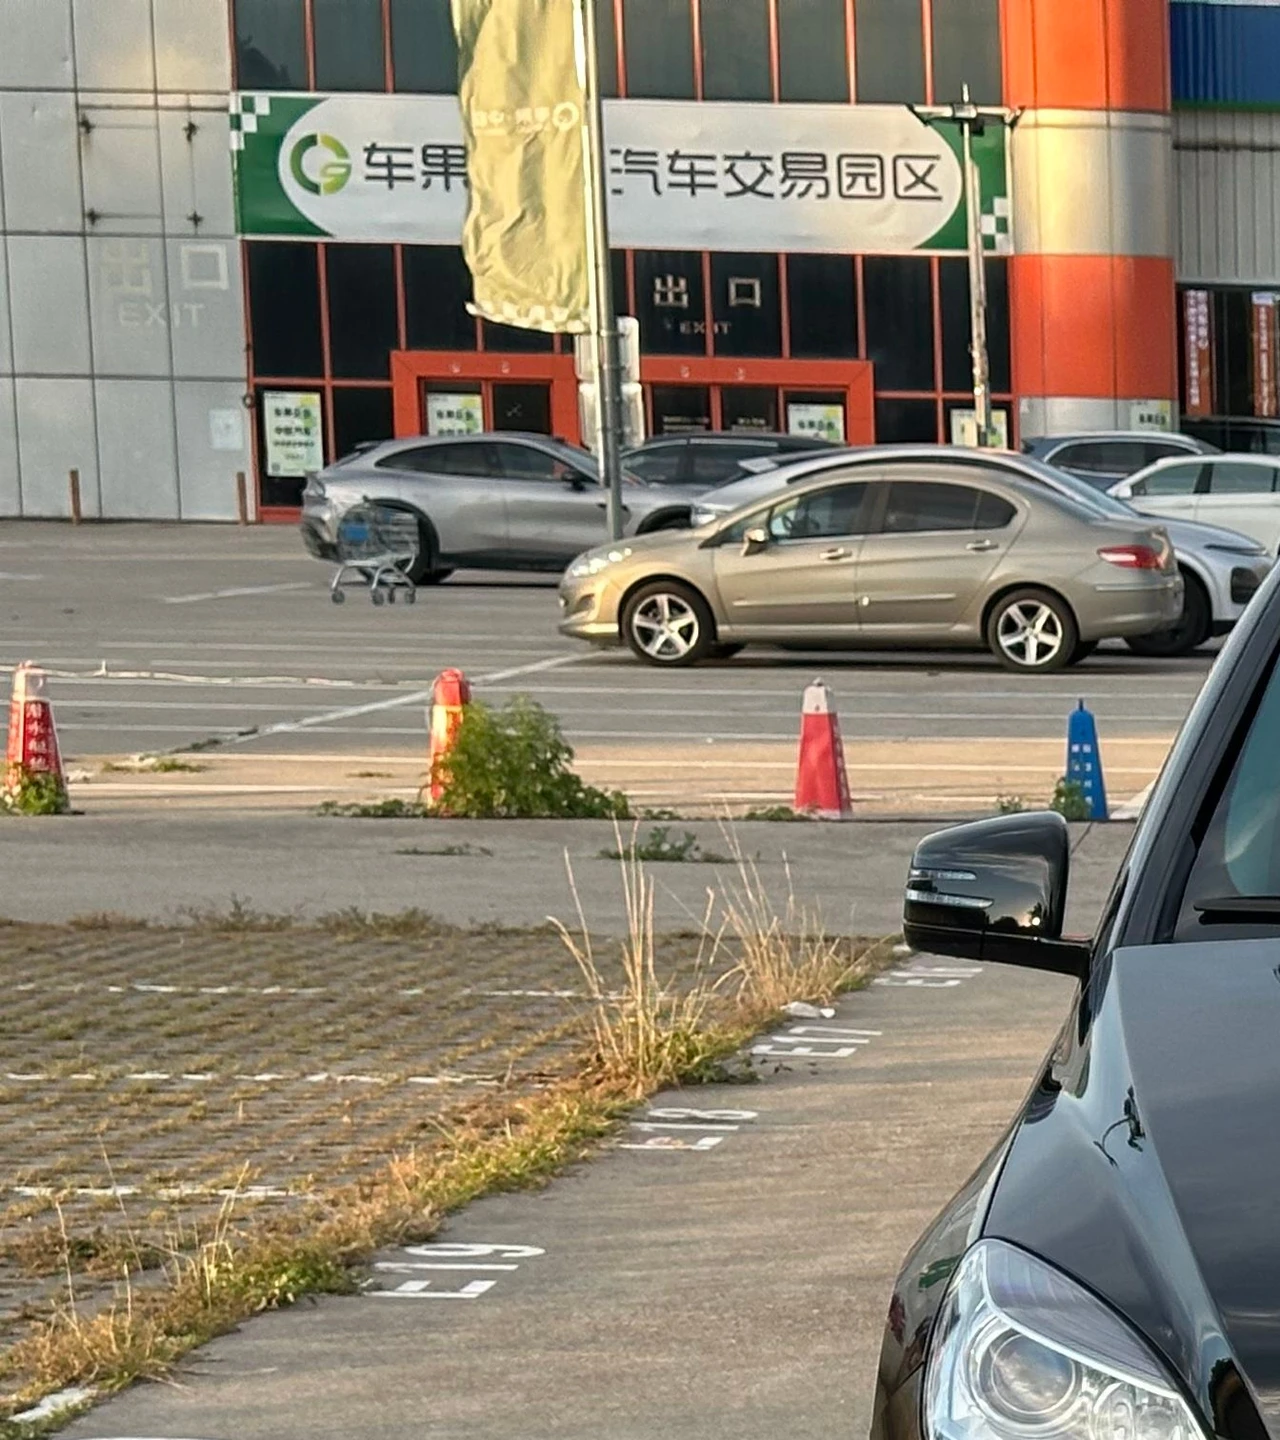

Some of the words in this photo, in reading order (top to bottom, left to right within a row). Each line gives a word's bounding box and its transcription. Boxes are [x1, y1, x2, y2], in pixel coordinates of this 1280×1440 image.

[654, 273, 761, 308] 出口
[119, 302, 205, 328] EXIT
[751, 1026, 882, 1057] E17
[363, 1242, 547, 1299] E19
